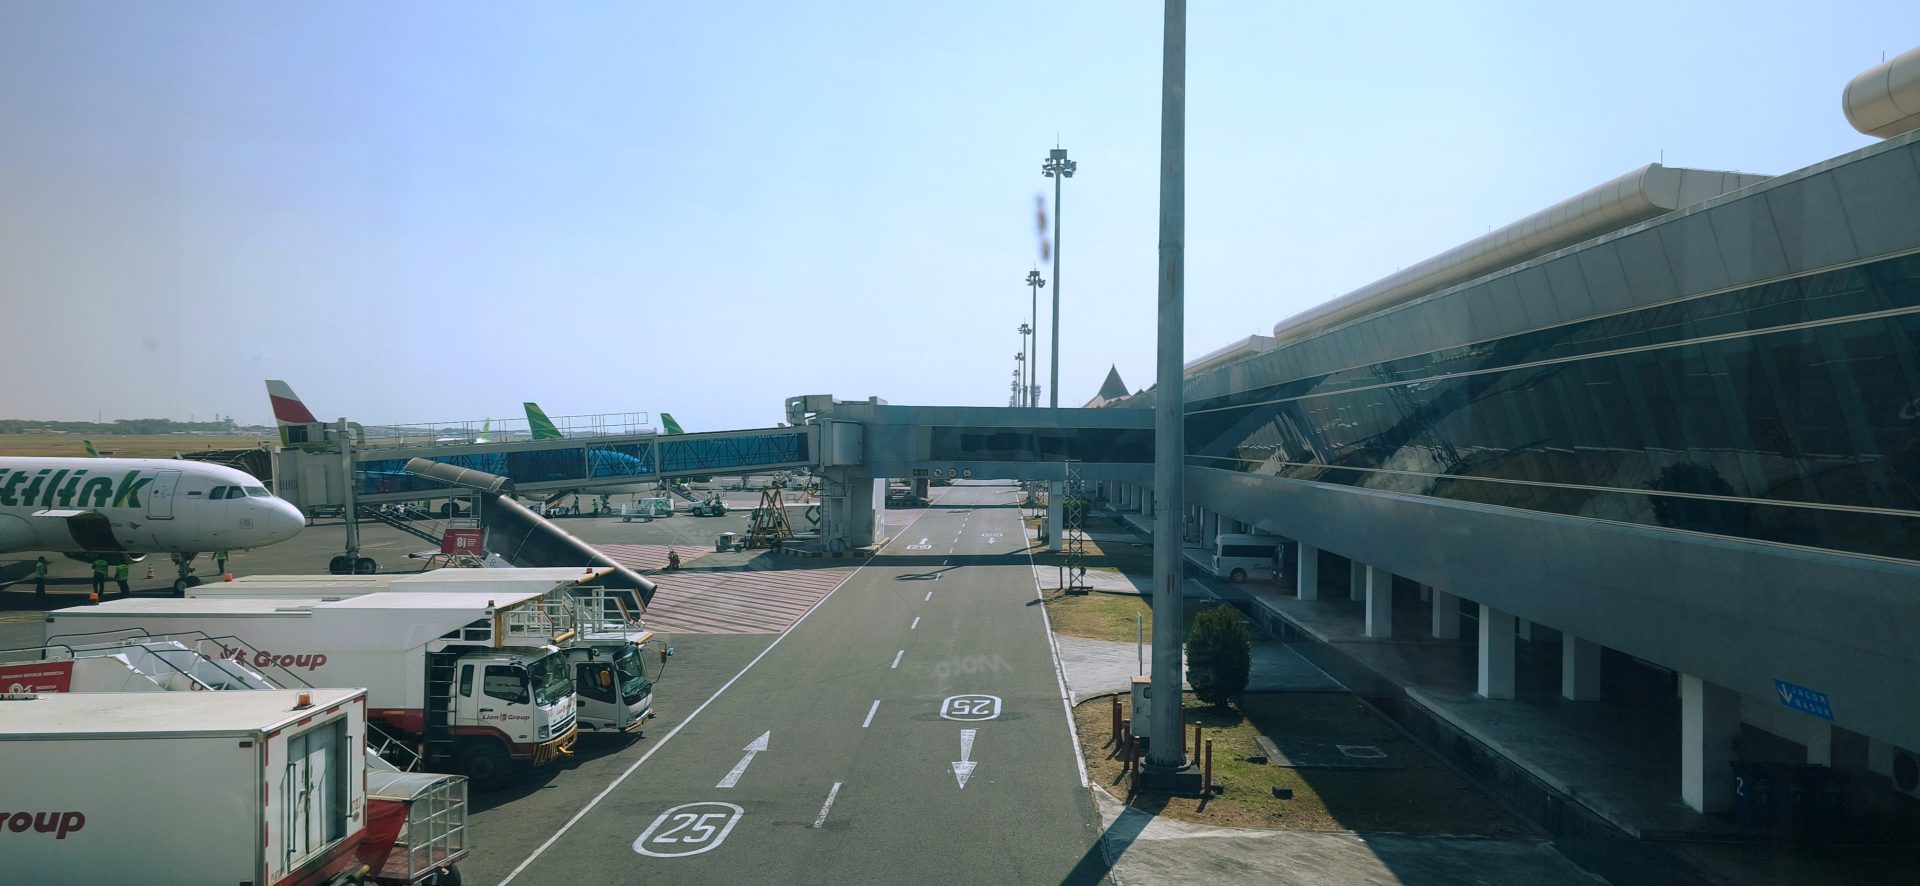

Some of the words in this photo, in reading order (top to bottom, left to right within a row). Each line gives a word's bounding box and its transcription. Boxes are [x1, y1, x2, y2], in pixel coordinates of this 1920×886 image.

[253, 650, 327, 671] Group
[952, 699, 990, 714] 25
[482, 713, 499, 721] Lion
[507, 713, 530, 722] Group
[1735, 776, 1744, 796] 2
[0, 811, 86, 839] roup
[652, 813, 727, 843] 25
